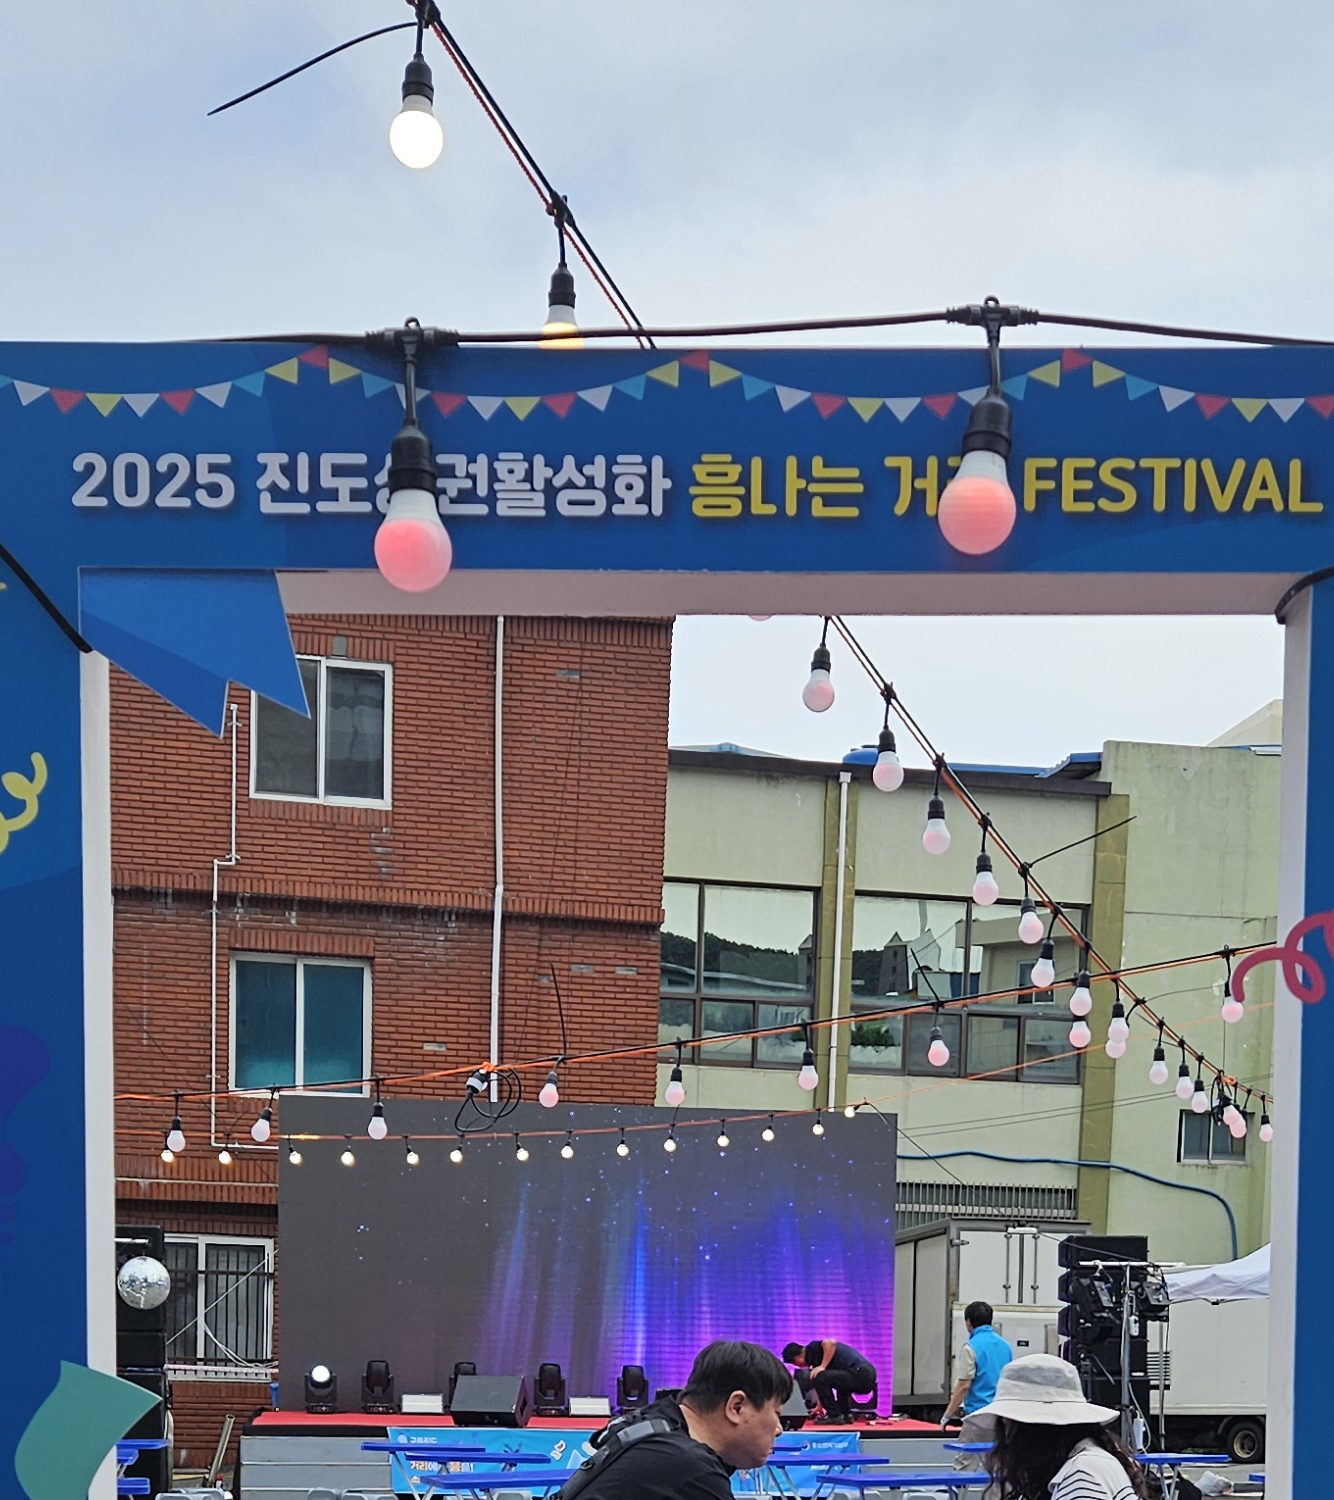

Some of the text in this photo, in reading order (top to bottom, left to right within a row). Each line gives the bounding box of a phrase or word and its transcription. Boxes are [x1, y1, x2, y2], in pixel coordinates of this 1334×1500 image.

[71, 452, 236, 509] 2025
[688, 452, 865, 519] 흥나는
[1023, 456, 1324, 514] FESTIVAL
